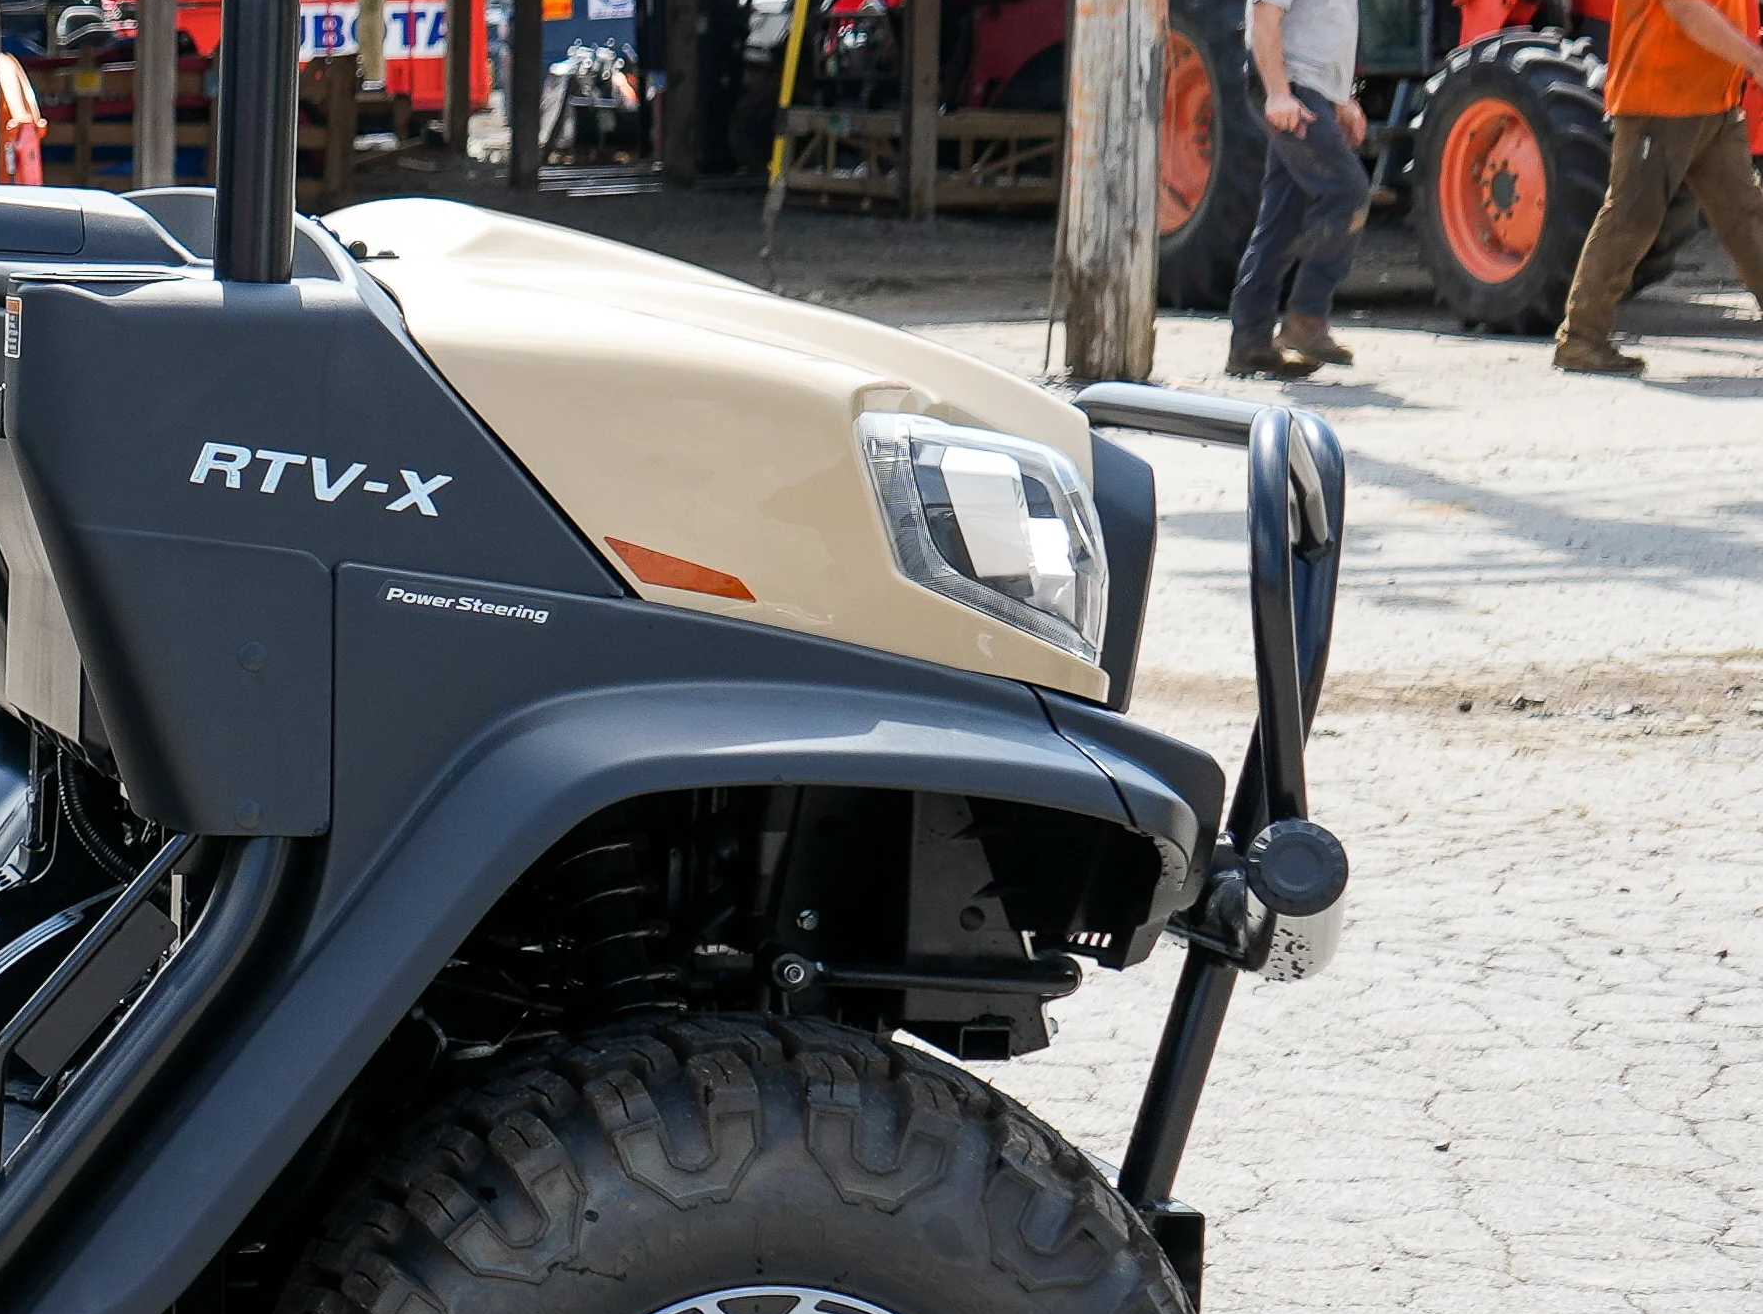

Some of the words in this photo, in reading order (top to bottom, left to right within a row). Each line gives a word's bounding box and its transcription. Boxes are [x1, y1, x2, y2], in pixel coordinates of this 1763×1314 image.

[189, 441, 453, 517] RTV-X
[386, 587, 455, 608] Power
[455, 596, 549, 624] Steering
